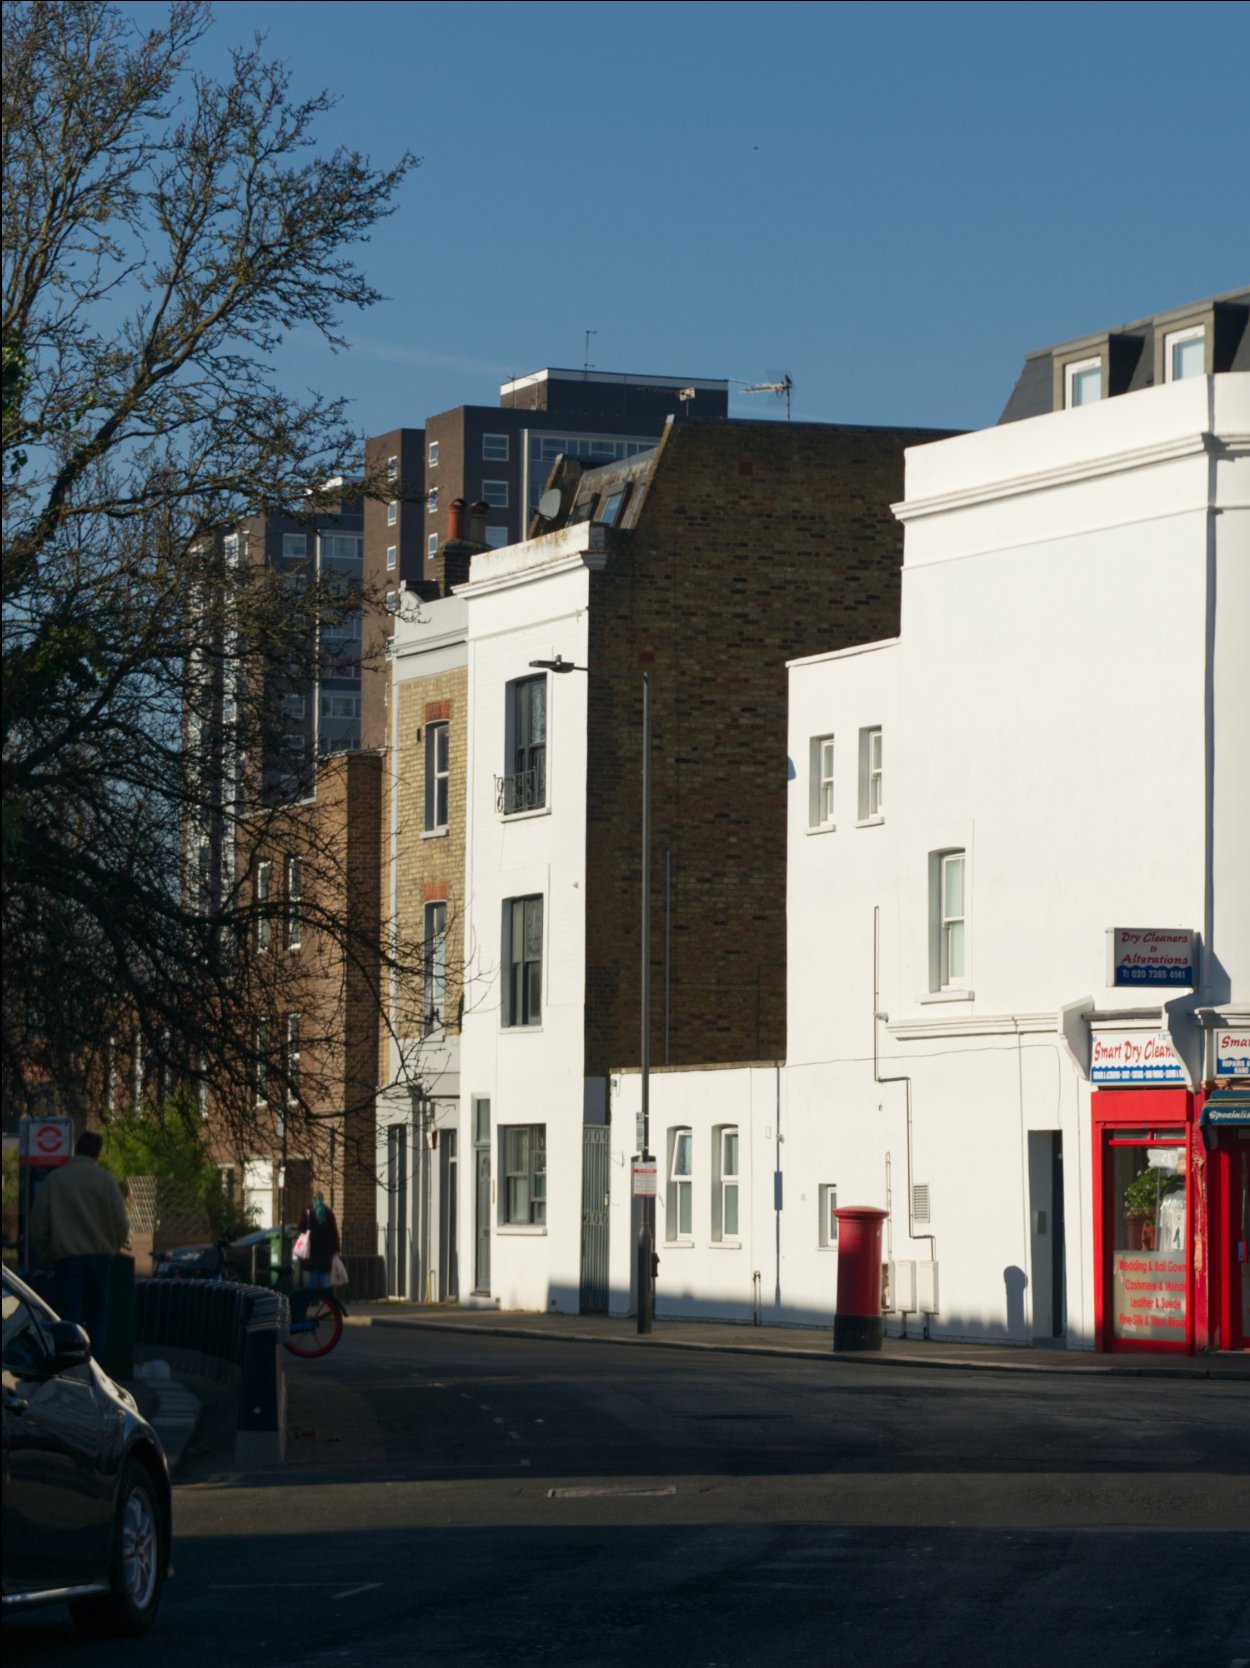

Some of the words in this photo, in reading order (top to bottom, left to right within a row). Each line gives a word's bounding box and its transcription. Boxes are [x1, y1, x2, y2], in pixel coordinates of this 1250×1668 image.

[1121, 931, 1141, 944] Dry
[1143, 932, 1188, 944] Cleaners
[1121, 952, 1189, 965] Alterations
[1131, 969, 1146, 978] 020
[1094, 1041, 1122, 1062] Smart
[1124, 1040, 1142, 1063] Dry
[1144, 1038, 1176, 1060] Clean
[1119, 1259, 1147, 1274] Wedding
[1168, 1260, 1187, 1272] Gown
[1165, 1281, 1187, 1292] Mohai
